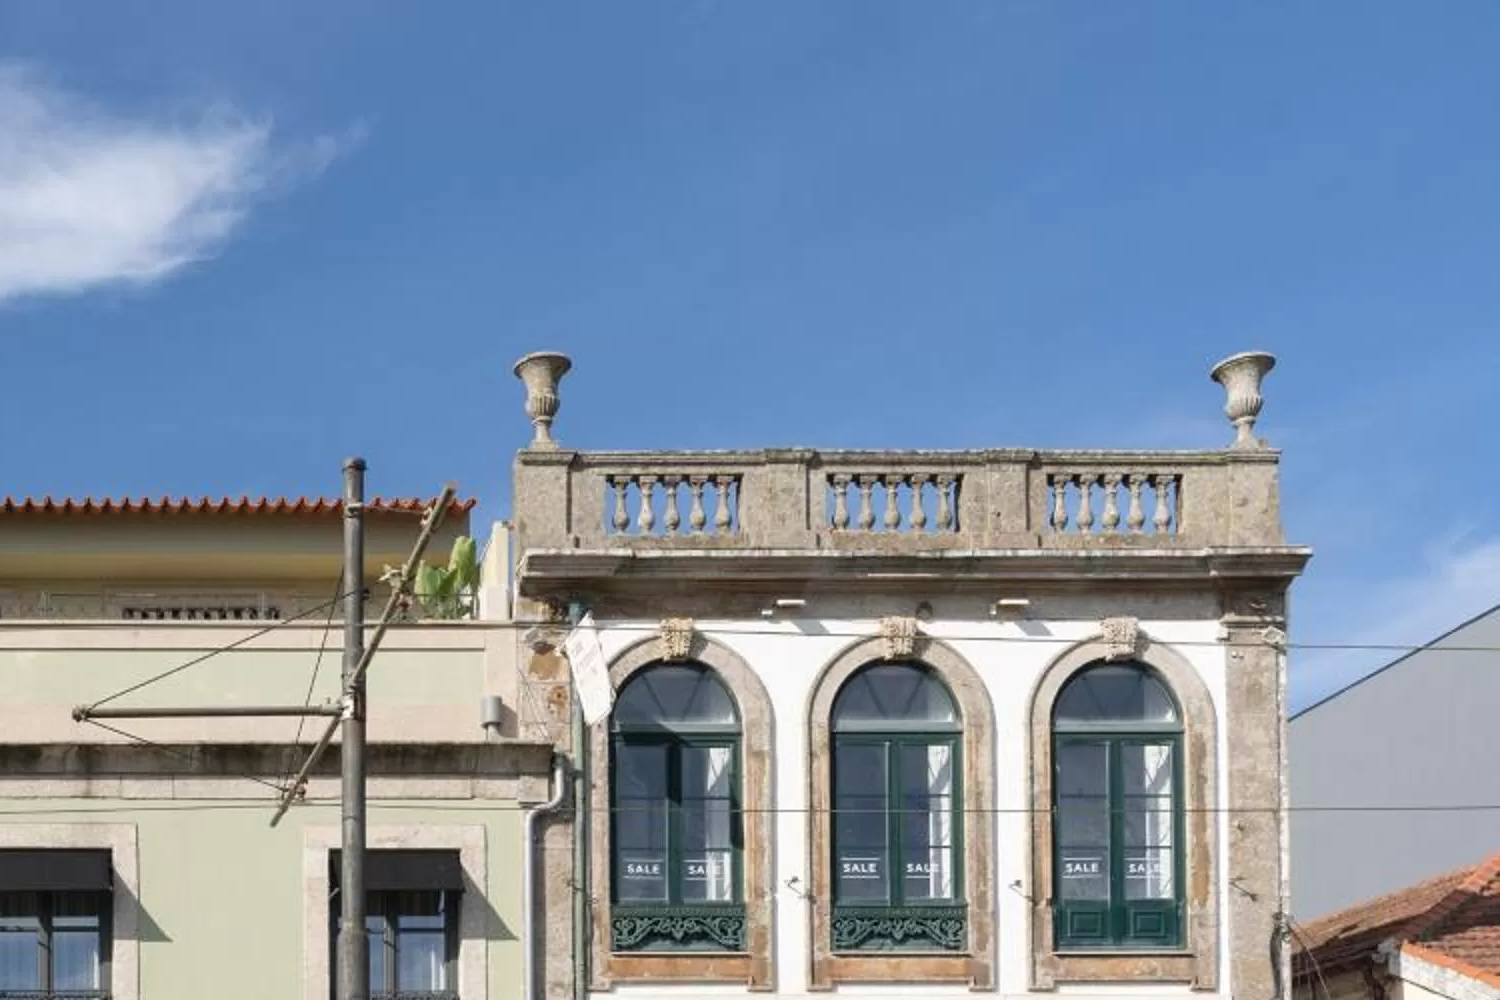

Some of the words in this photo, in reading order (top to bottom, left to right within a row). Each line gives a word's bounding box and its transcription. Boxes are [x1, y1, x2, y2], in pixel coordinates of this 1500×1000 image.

[627, 863, 661, 875] SALE
[687, 863, 723, 875] SAE
[842, 862, 878, 873] SALE
[1064, 862, 1099, 873] SALE
